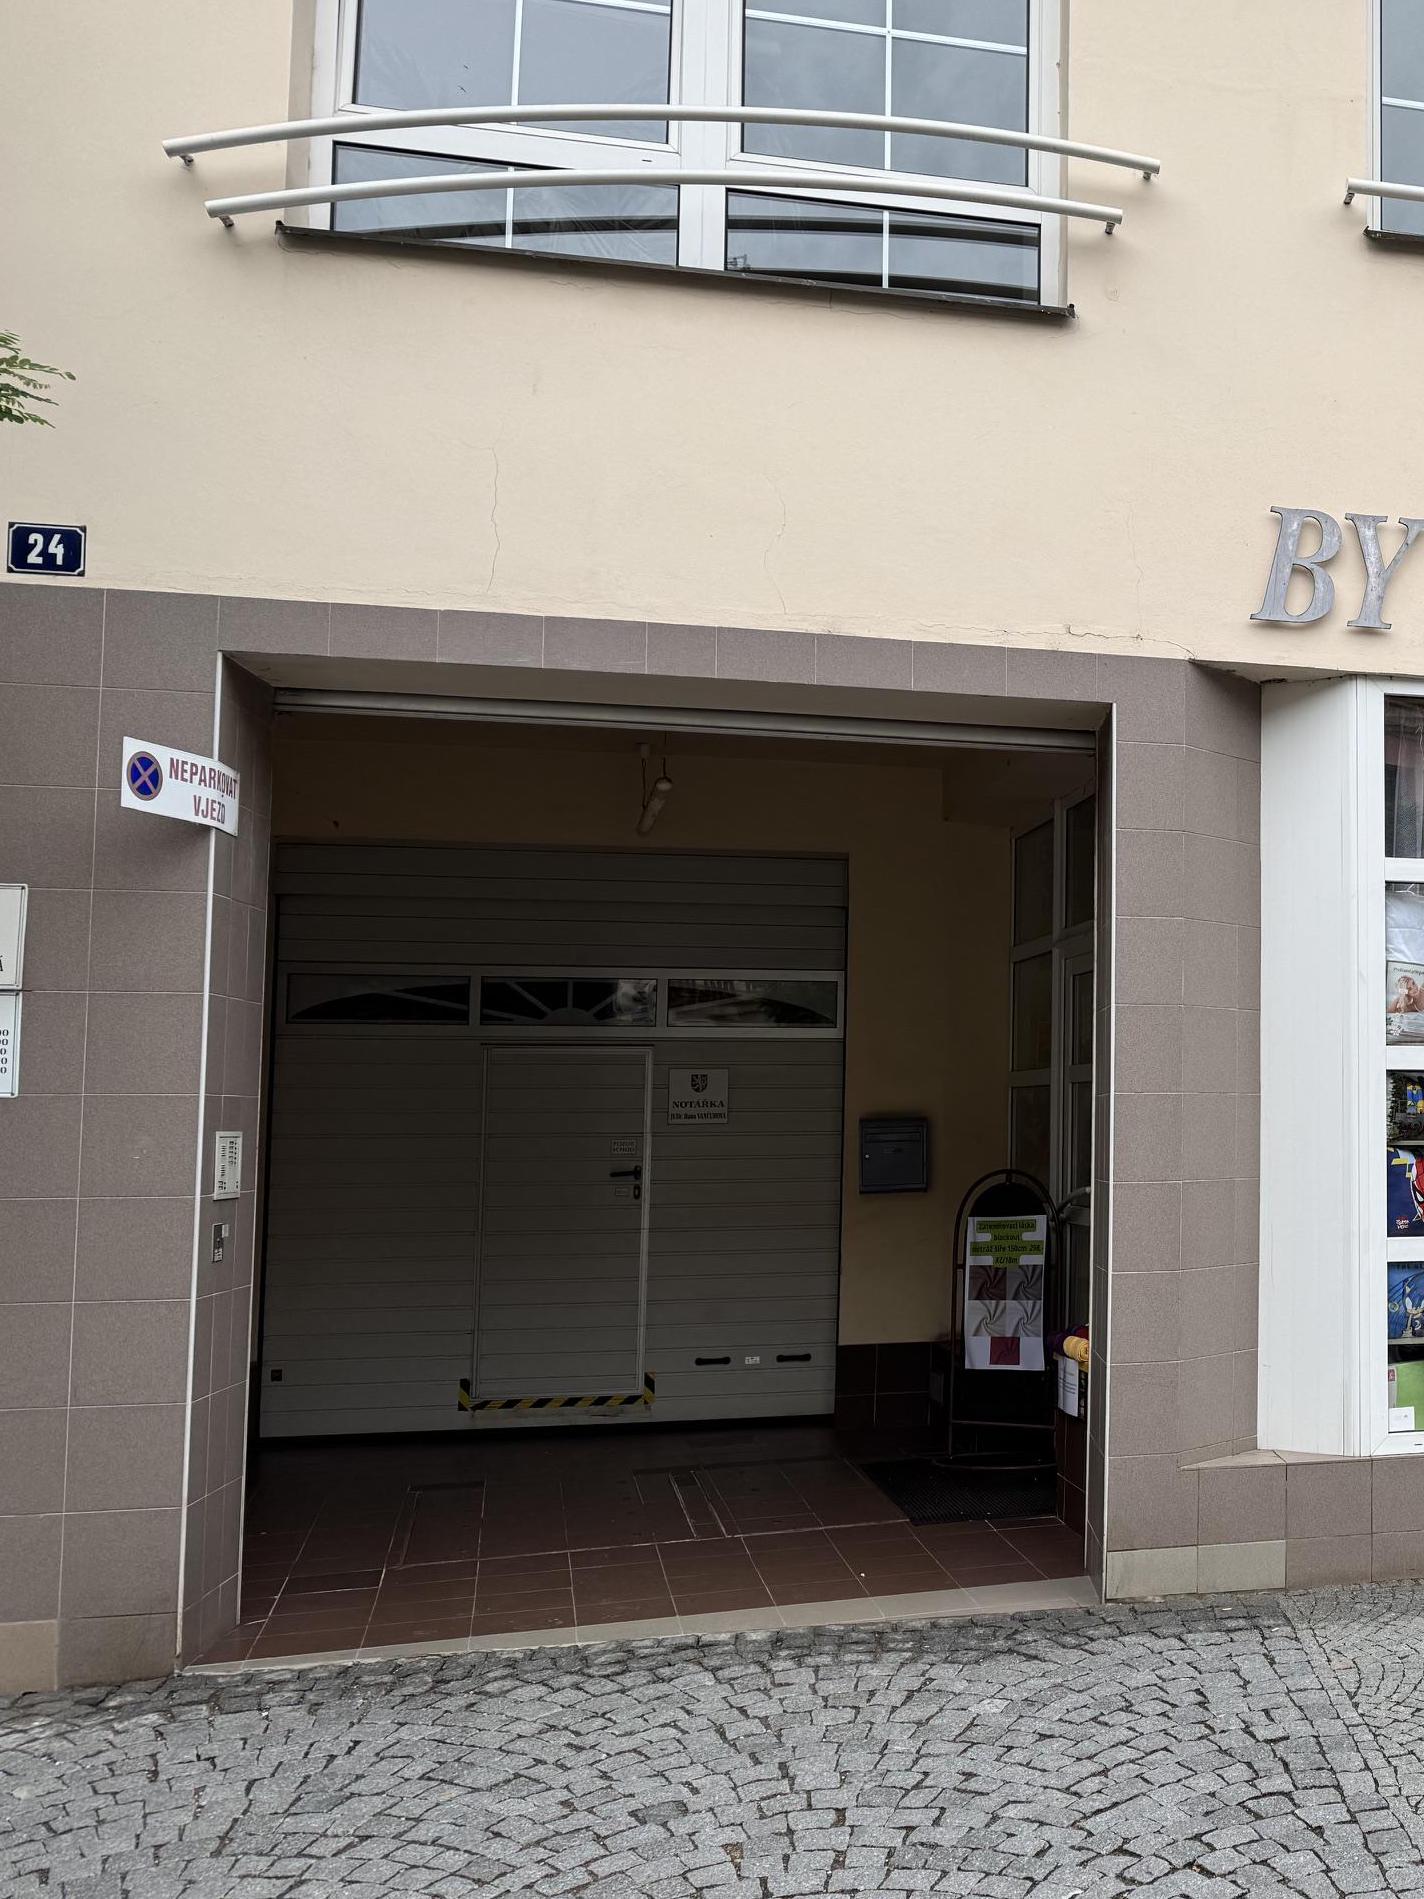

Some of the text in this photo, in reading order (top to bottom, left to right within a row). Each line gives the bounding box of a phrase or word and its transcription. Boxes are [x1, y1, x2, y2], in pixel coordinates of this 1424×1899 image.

[26, 532, 65, 566] 24
[168, 757, 238, 800] NEPARKOVAT
[193, 794, 226, 825] VJEZD
